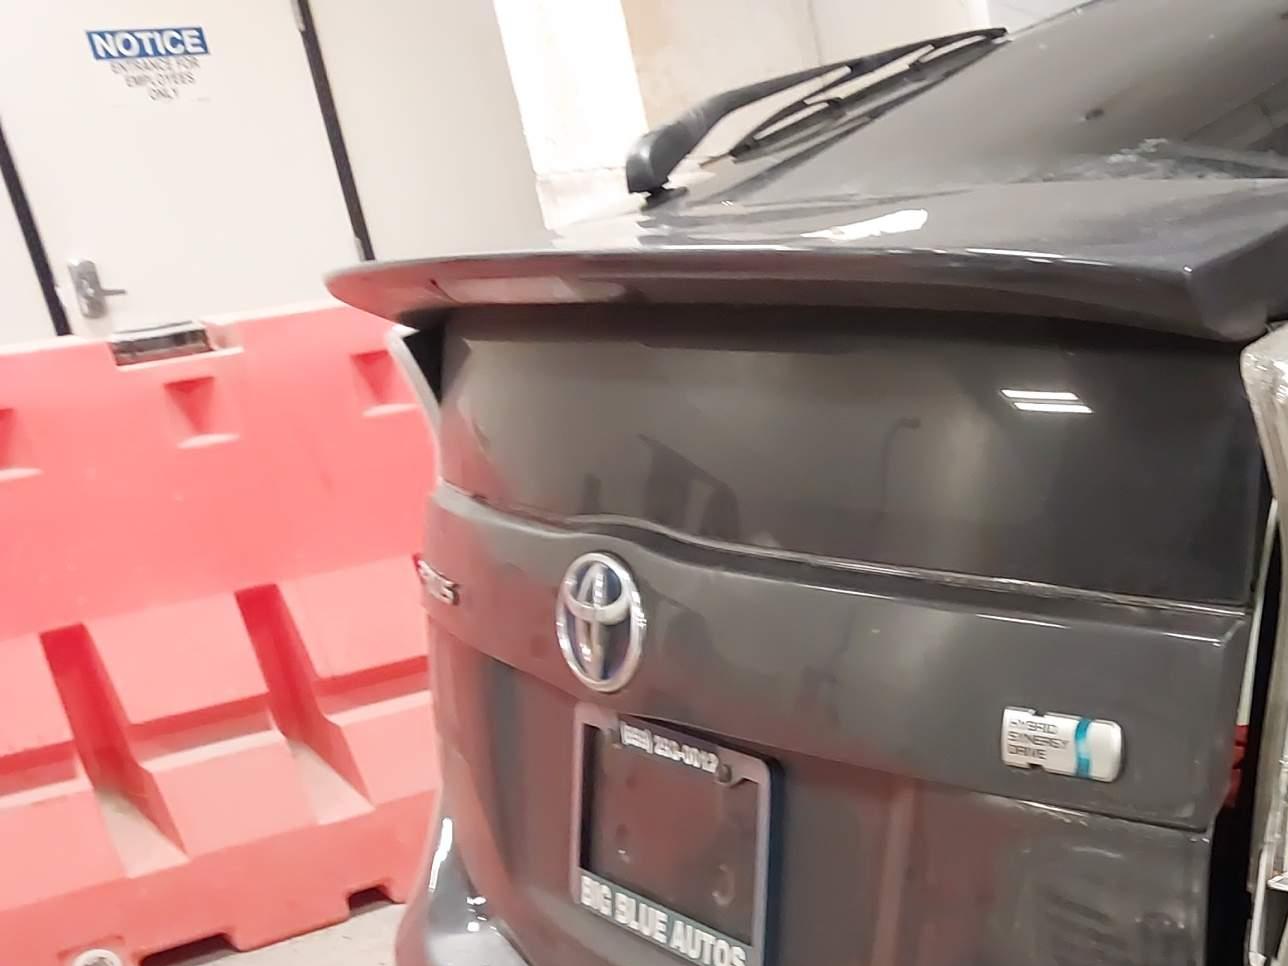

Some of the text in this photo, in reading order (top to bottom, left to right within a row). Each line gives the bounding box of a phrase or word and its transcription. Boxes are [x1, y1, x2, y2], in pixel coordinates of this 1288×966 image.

[91, 28, 206, 58] NOTICE
[149, 86, 179, 101] ONLY
[580, 874, 613, 917] BIG
[614, 891, 669, 945] BLUE
